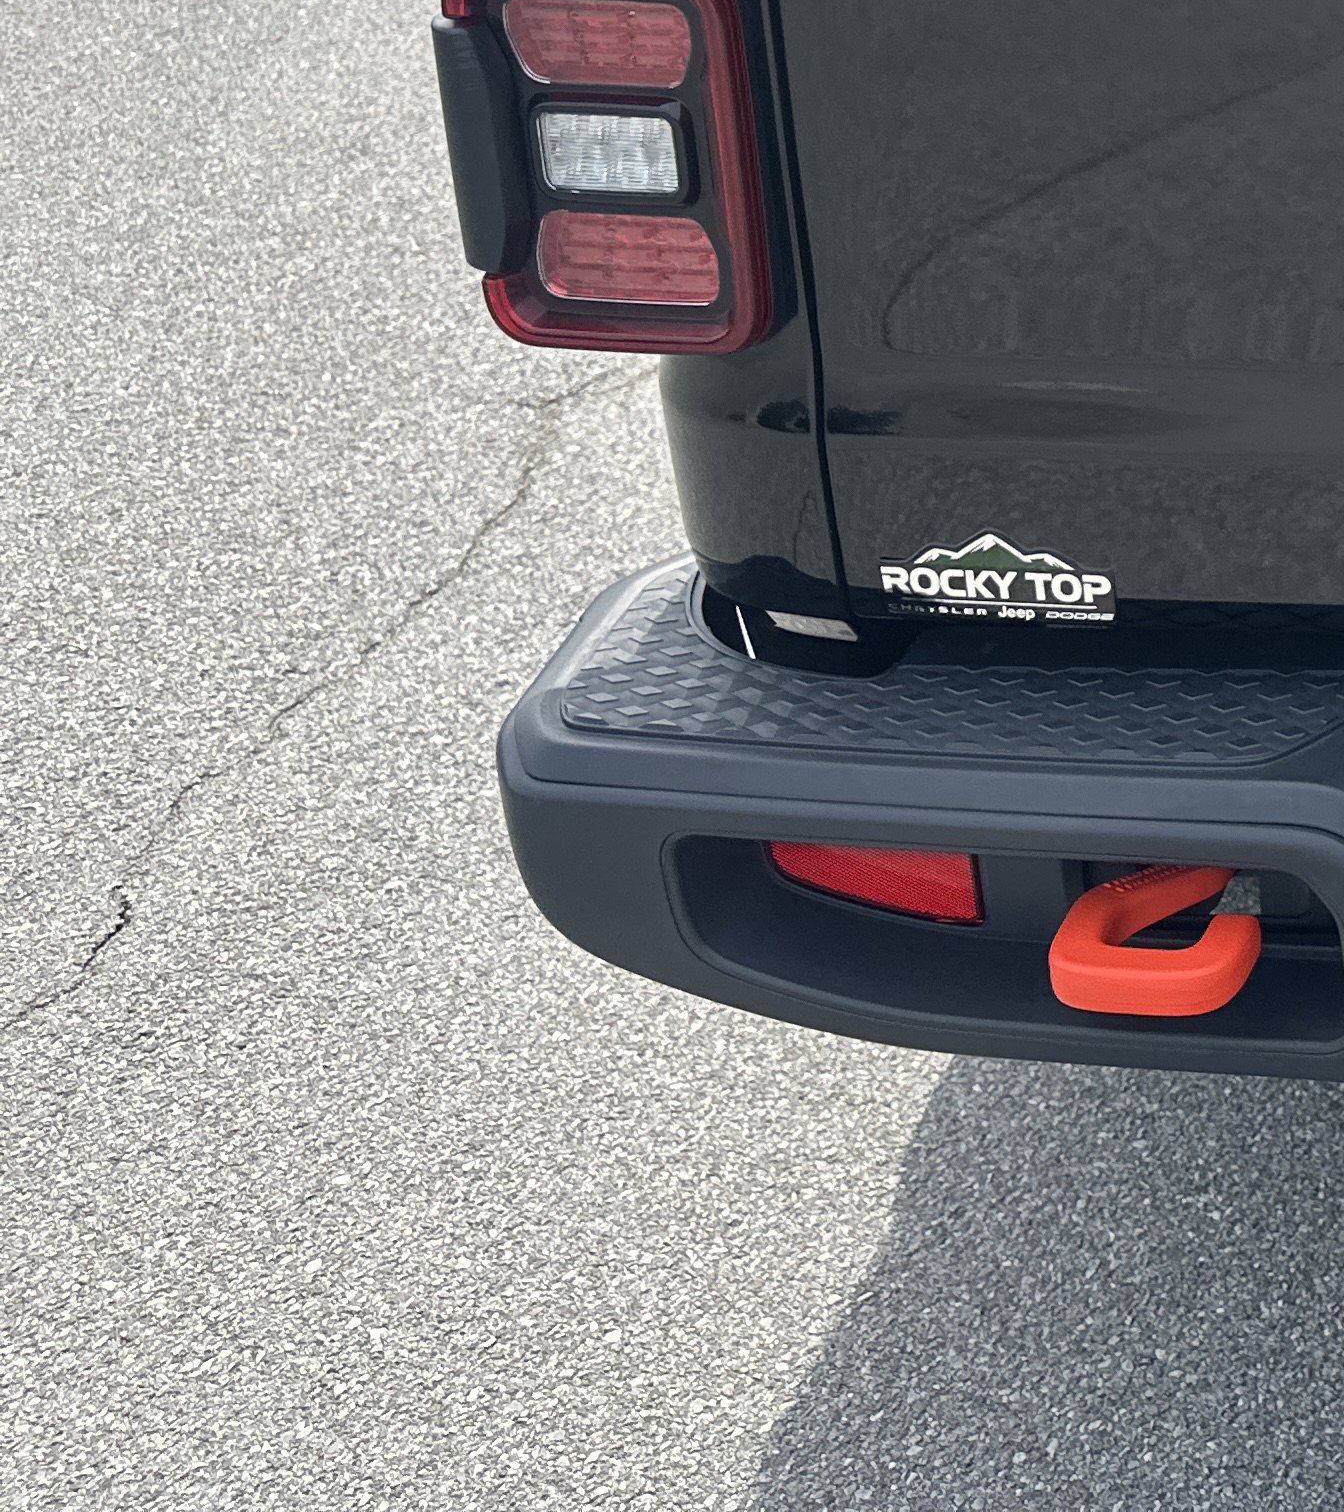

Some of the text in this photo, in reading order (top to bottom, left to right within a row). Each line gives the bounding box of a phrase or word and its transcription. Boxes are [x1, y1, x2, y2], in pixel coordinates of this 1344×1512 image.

[880, 566, 1112, 603] ROCKY TOP
[998, 605, 1036, 621] Jeep
[1045, 611, 1115, 621] DODGE
